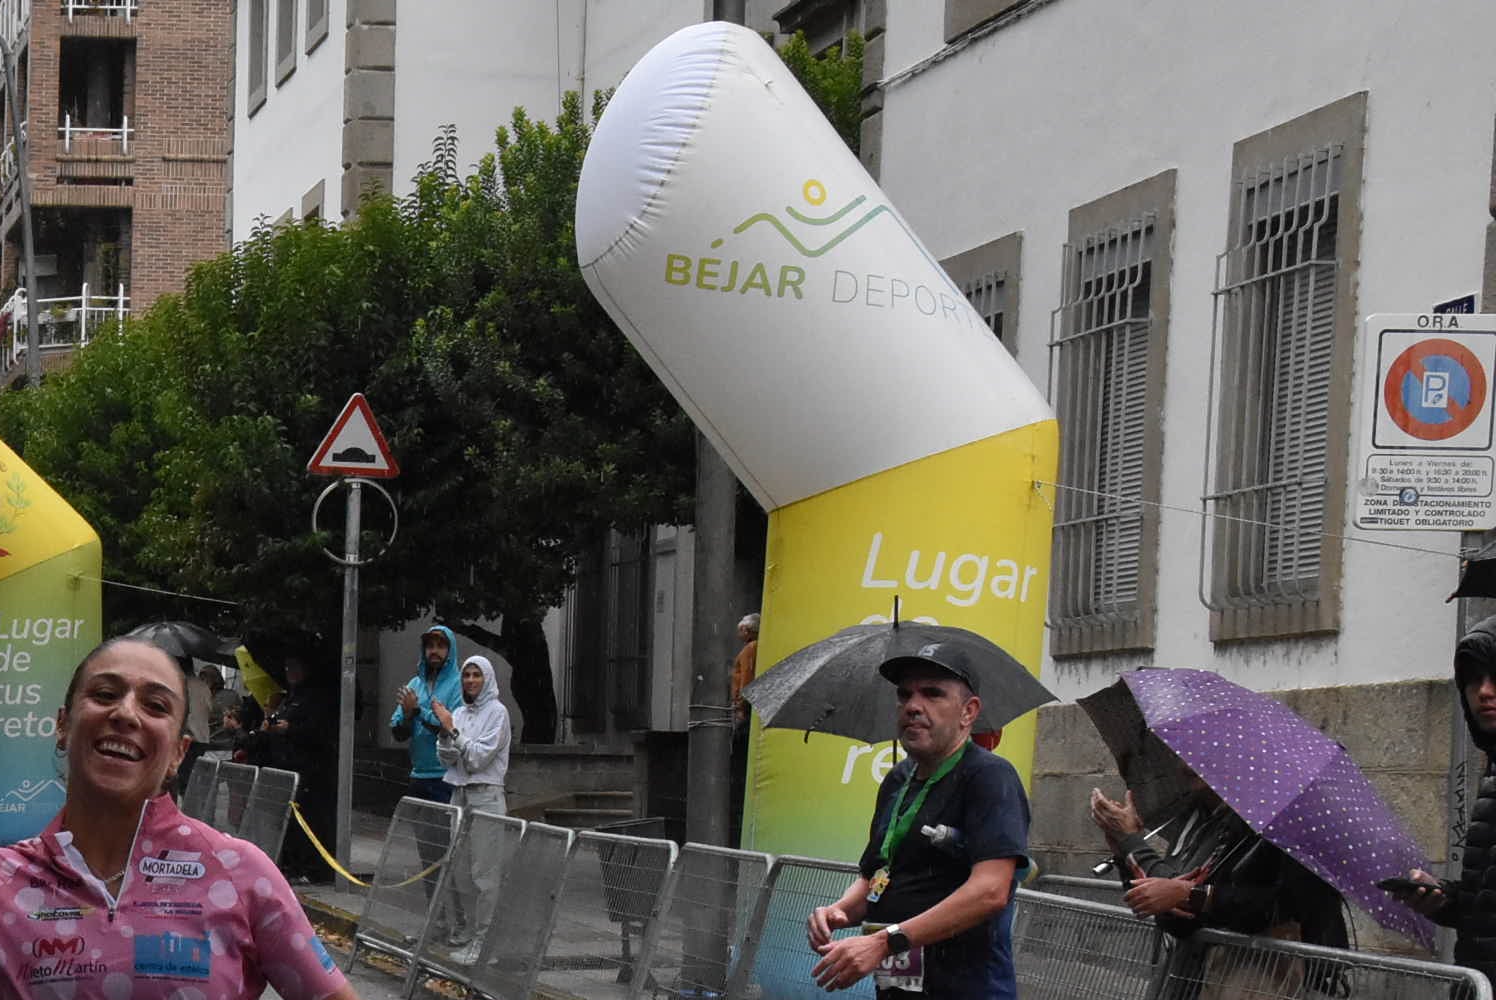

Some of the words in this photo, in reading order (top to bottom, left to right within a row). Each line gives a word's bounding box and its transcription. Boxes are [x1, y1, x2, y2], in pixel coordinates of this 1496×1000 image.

[663, 238, 805, 300] BÉJAR
[1364, 499, 1388, 507] ZONA
[1414, 500, 1492, 509] STACIONAMIENTO
[1415, 509, 1422, 517] Y
[1425, 509, 1486, 518] CONTROLADO
[1415, 519, 1474, 527] OBLIGATORIO
[861, 532, 1038, 607] Lugar
[142, 859, 201, 877] MORTADELA
